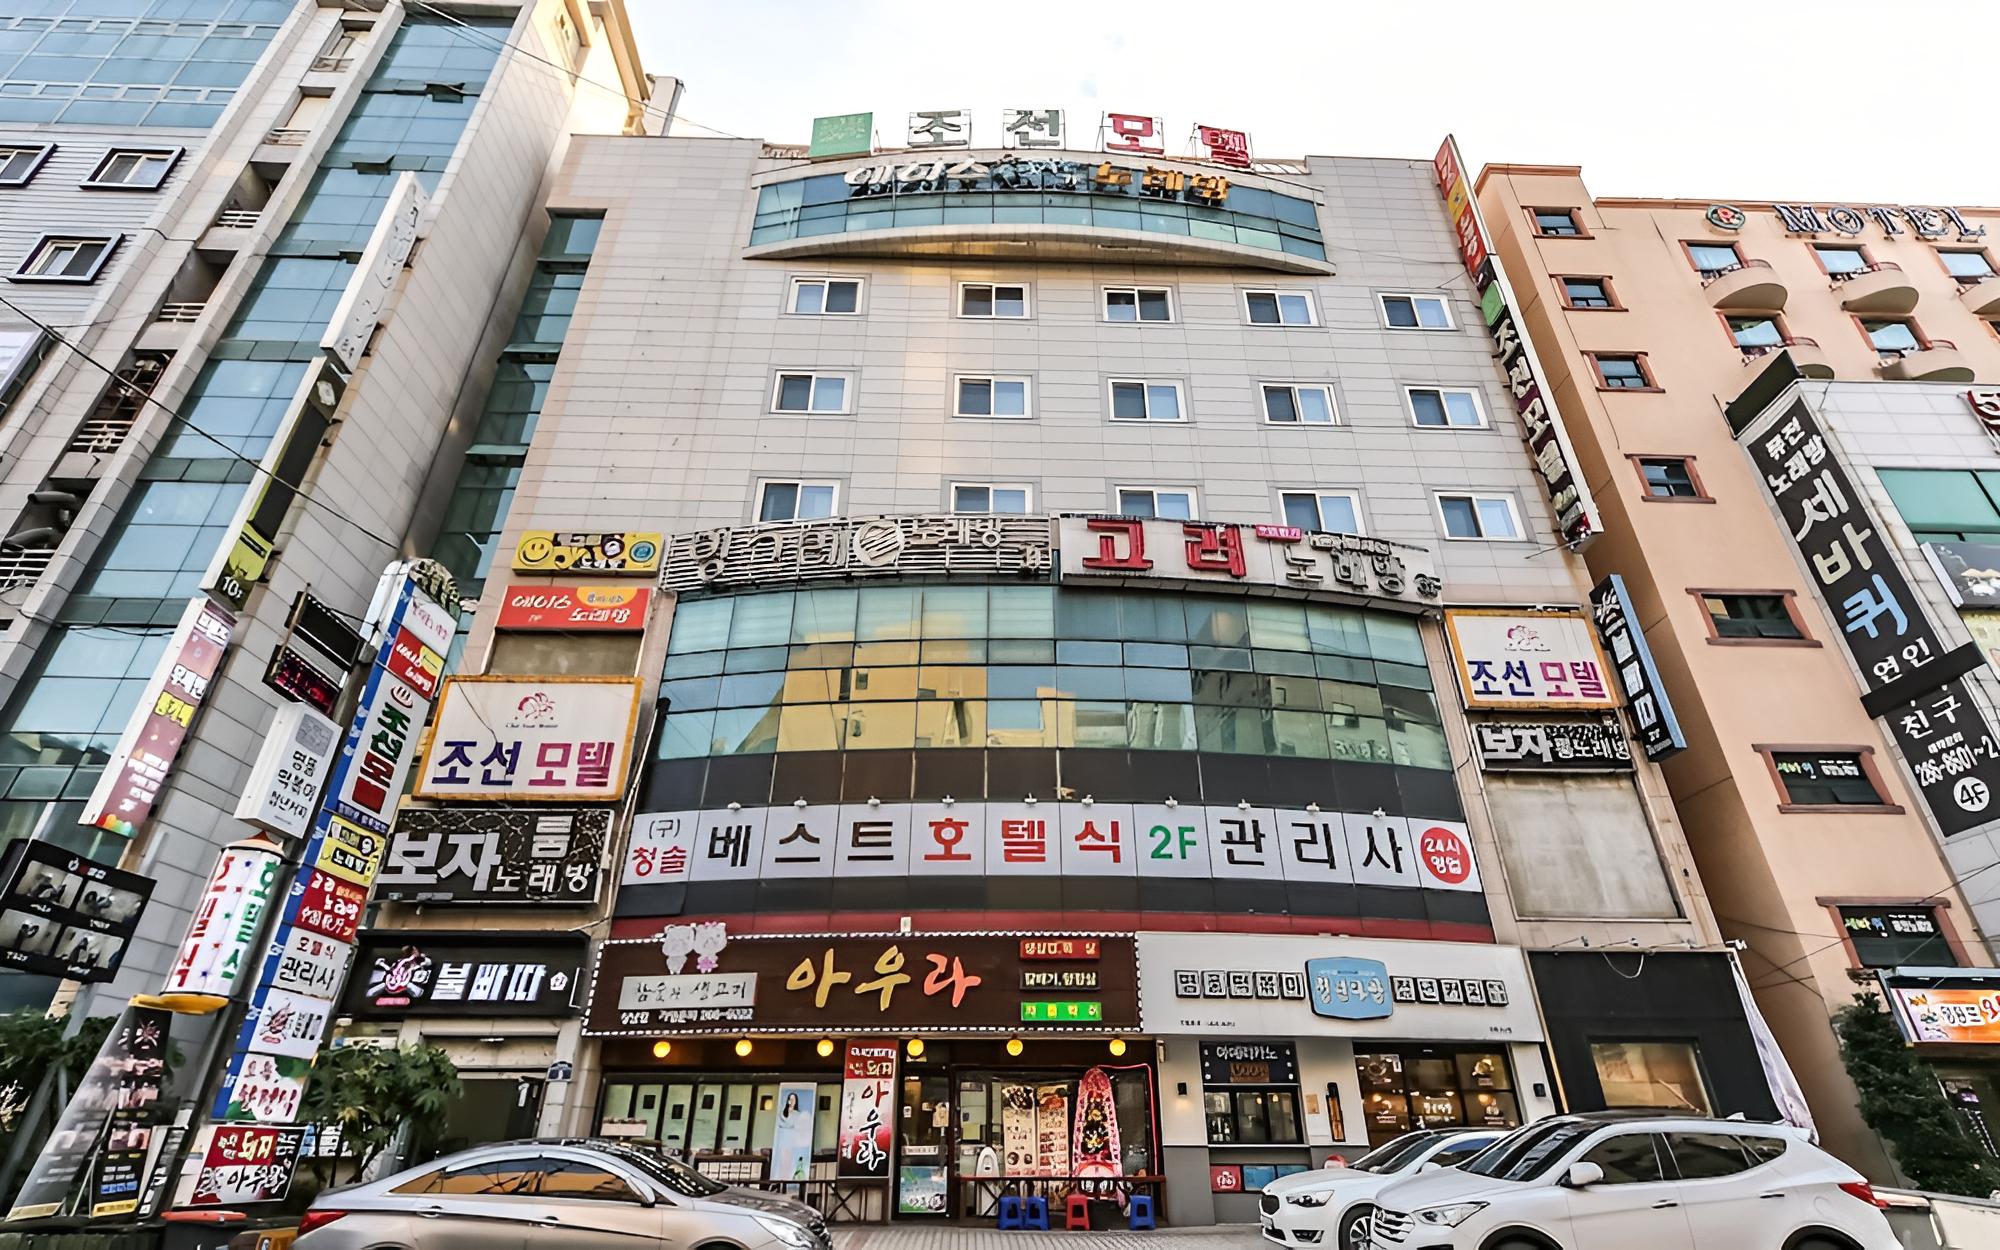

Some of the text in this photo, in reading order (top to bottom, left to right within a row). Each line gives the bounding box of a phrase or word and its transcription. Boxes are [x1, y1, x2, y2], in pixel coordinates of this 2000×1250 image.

[1772, 204, 1986, 236] MOTEL
[1767, 435, 1827, 496] 노래방
[1796, 468, 1908, 639] 세바퀴
[1467, 660, 1606, 698] 조선 모텔
[1873, 636, 1934, 684] 연인
[1900, 694, 1962, 740] 친구
[431, 741, 615, 787] 조선 모텔
[1959, 783, 1986, 806] 4F
[648, 818, 682, 839] (구)
[1149, 824, 1197, 860] 2F
[1219, 819, 1403, 873] 관리사
[375, 832, 503, 892] 보자
[492, 863, 594, 893] 노래방
[632, 845, 687, 877] 청솔
[279, 956, 336, 991] 관리사
[786, 944, 982, 1011] 아우라
